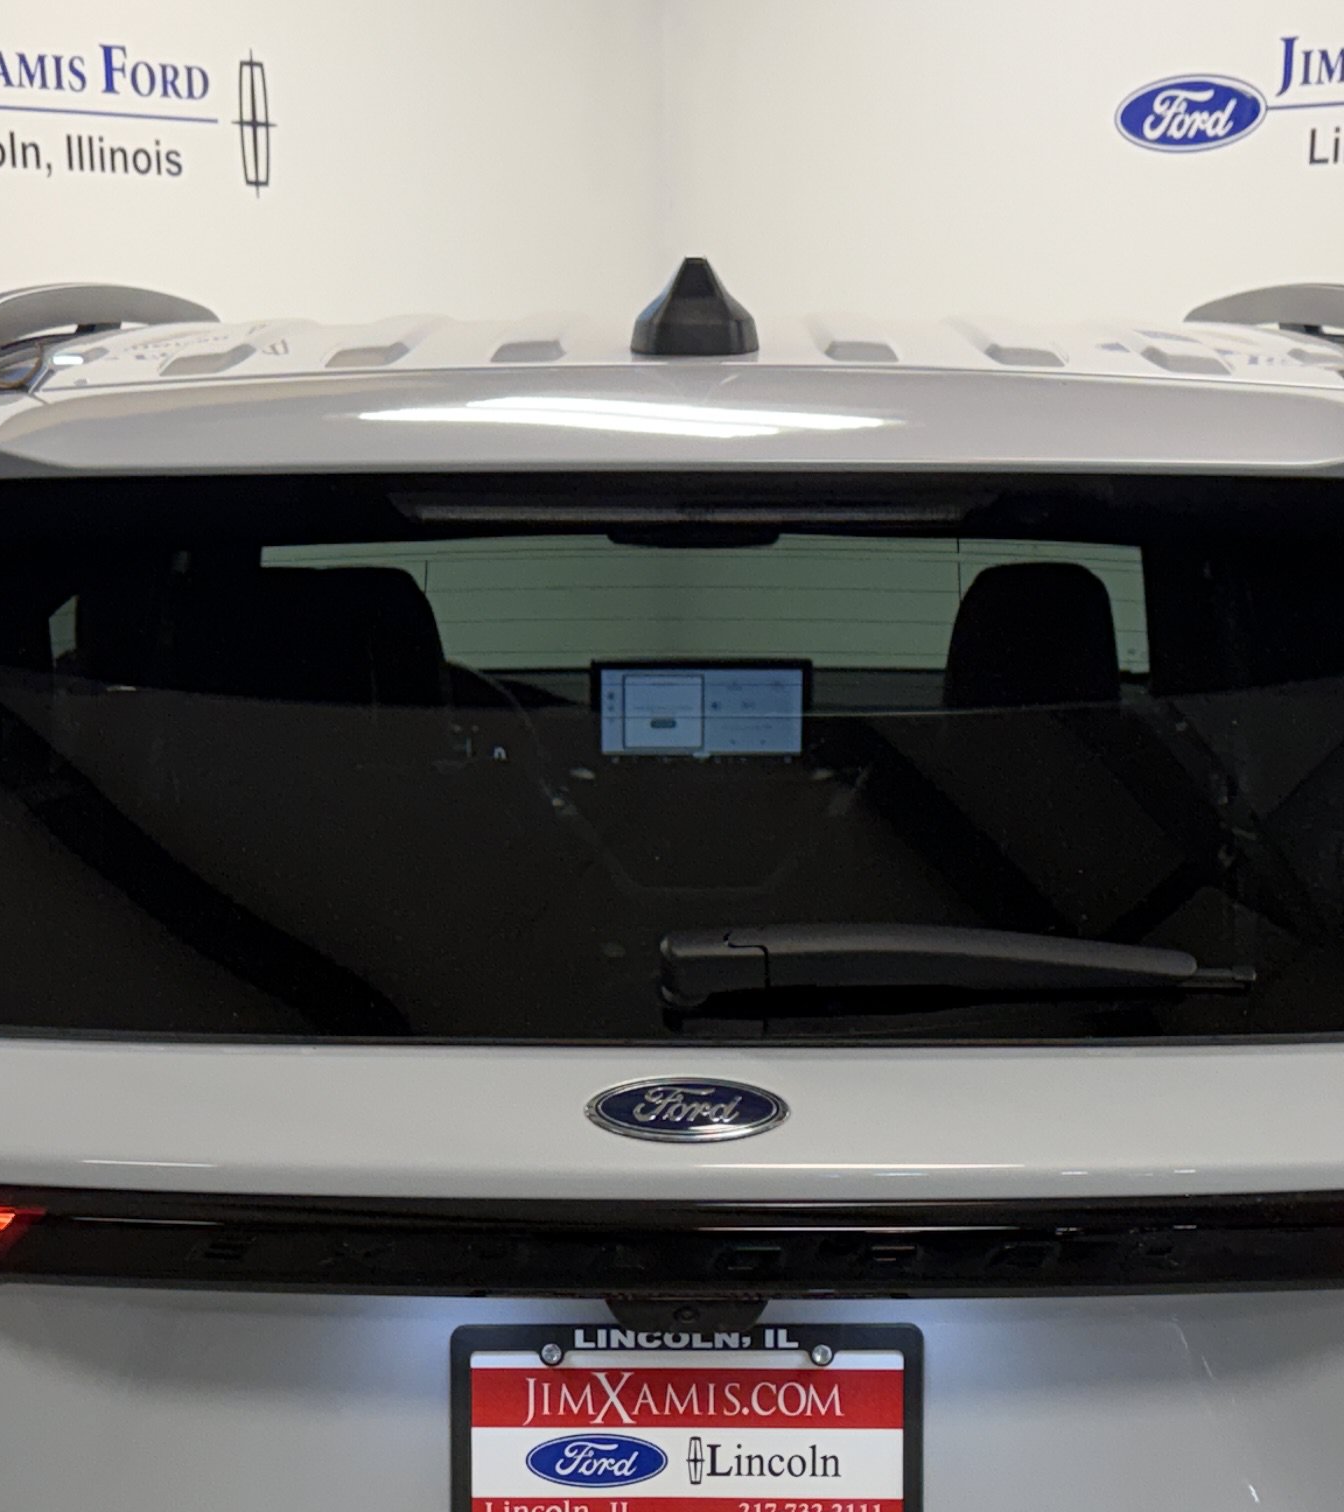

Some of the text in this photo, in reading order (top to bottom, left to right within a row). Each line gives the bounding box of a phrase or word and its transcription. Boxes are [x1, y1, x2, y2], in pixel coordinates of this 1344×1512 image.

[99, 44, 210, 101] FORD
[1141, 90, 1234, 140] Ford
[65, 134, 183, 176] Illinois
[633, 1087, 743, 1122] Ford
[574, 1328, 799, 1349] LINCOLN, IL
[555, 1441, 841, 1479] Ford Lincoln
